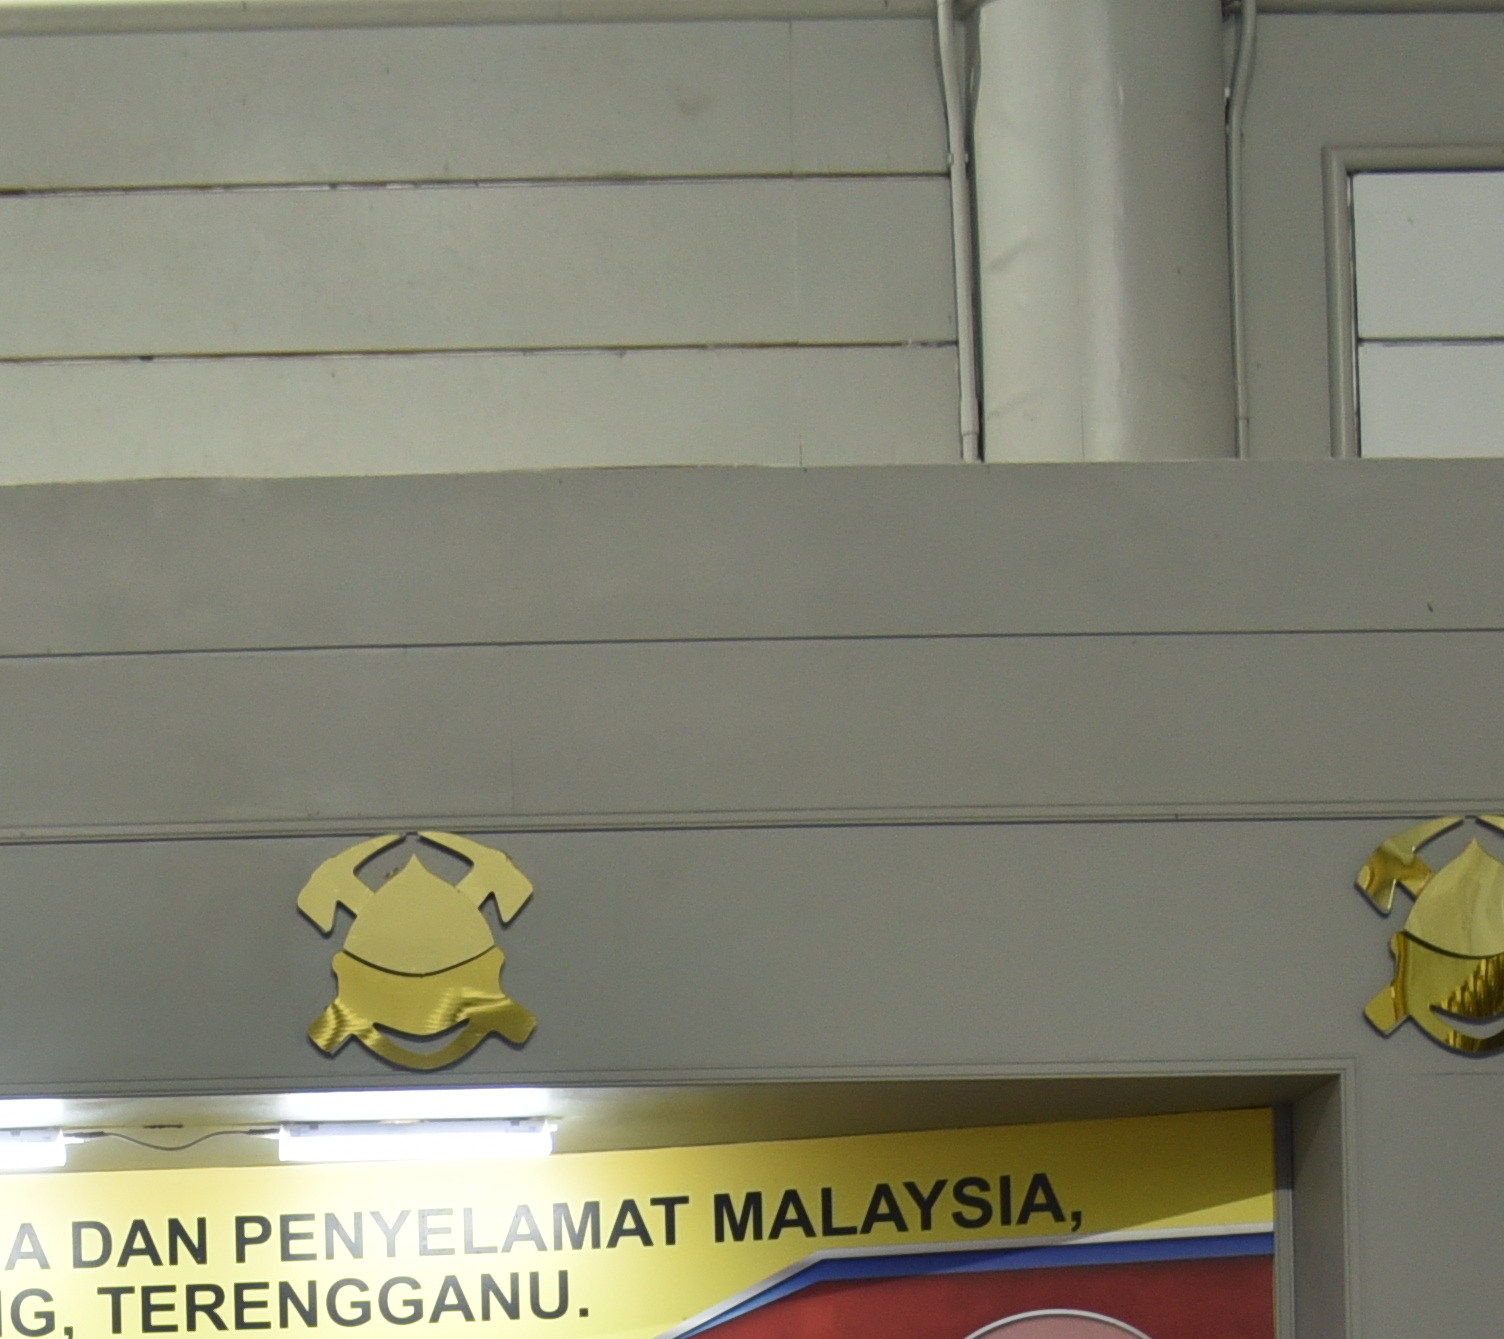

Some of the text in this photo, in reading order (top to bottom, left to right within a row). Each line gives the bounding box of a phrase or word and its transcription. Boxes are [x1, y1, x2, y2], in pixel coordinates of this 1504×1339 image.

[70, 1216, 210, 1270] DAN
[234, 1195, 691, 1266] PENYELAMAT
[713, 1171, 1084, 1244] MALAYSIA,
[97, 1269, 592, 1337] TERENGGANU.
